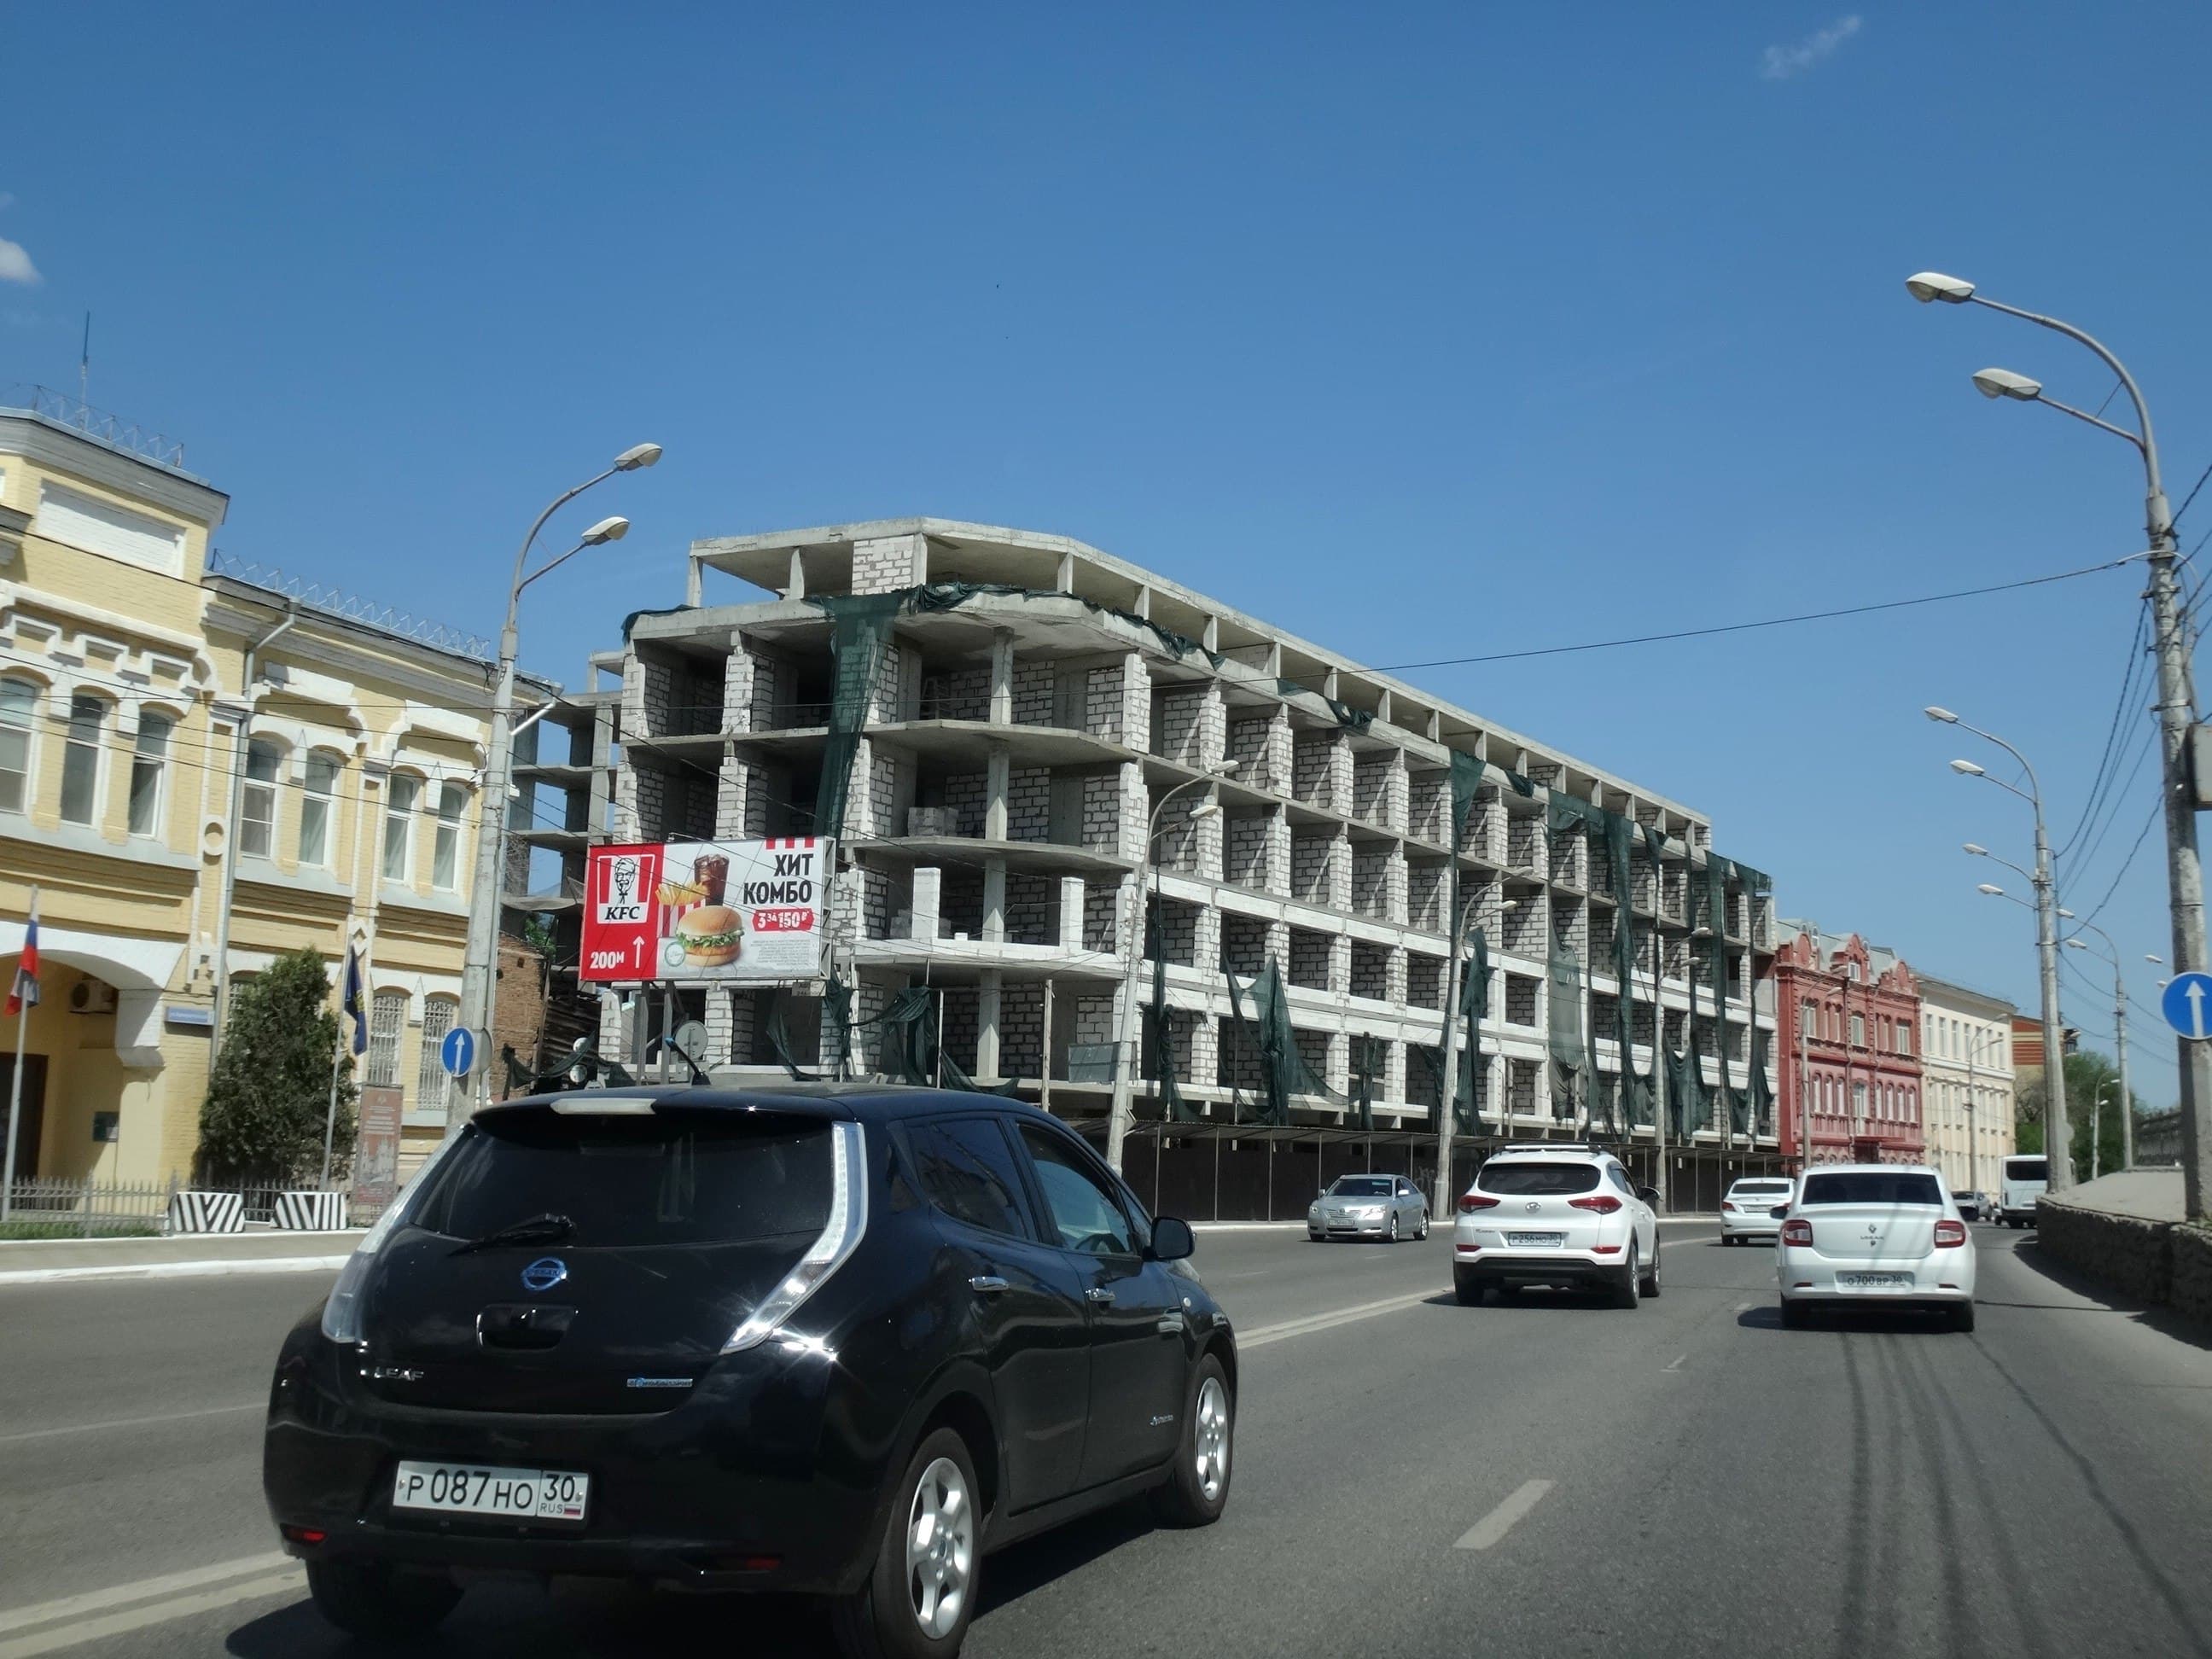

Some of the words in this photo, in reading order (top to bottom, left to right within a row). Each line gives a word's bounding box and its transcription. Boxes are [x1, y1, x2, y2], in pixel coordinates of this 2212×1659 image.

[774, 853, 814, 876] ХИТ
[743, 880, 812, 905] КОМБО
[605, 906, 640, 920] KFC
[544, 1473, 576, 1502] 30
[539, 1503, 563, 1514] RUS
